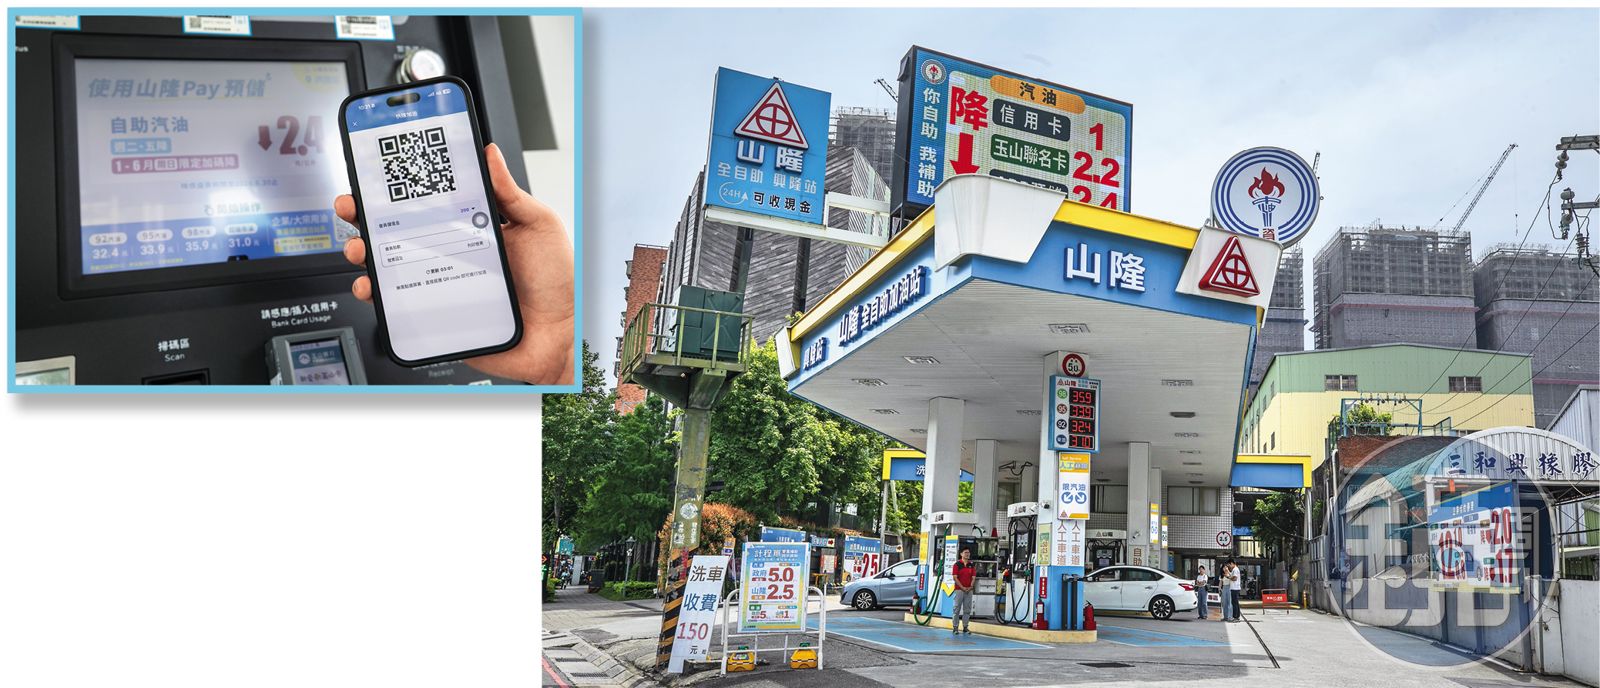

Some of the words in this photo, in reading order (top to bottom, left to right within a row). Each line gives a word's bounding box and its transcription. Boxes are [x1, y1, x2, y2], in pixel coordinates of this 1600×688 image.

[1019, 82, 1057, 106] 汽油
[921, 87, 940, 139] 你自助
[950, 85, 989, 131] 降
[111, 116, 189, 134] 自助汽油
[1000, 104, 1062, 135] 信用卡
[1089, 122, 1104, 151] 1
[737, 140, 804, 173] 山隆
[994, 138, 1067, 171] 玉山聯名卡
[718, 162, 763, 183] 全自助
[773, 172, 817, 195] 興隆站
[917, 145, 937, 198] 我補助
[1073, 151, 1120, 188] 2.2
[722, 187, 740, 198] 24H
[754, 192, 811, 213] 可收現金
[1073, 185, 1117, 210] 24
[185, 240, 210, 252] 35.9
[228, 237, 251, 248] 31.0
[1064, 243, 1146, 292] 山隆
[291, 317, 309, 325] Card
[309, 315, 331, 323] Usage
[158, 338, 190, 352] 掃碼區
[165, 352, 185, 362] Scan
[1062, 483, 1086, 491] 限汽油
[1491, 508, 1511, 544] 2.0
[690, 565, 724, 582] 洗車
[768, 567, 794, 582] 5.0
[1496, 548, 1513, 583] 1.7
[683, 593, 717, 612] 收費
[752, 587, 766, 595] 山隆
[767, 584, 794, 600] 2.5
[677, 622, 709, 640] 150
[689, 645, 698, 655] 元
